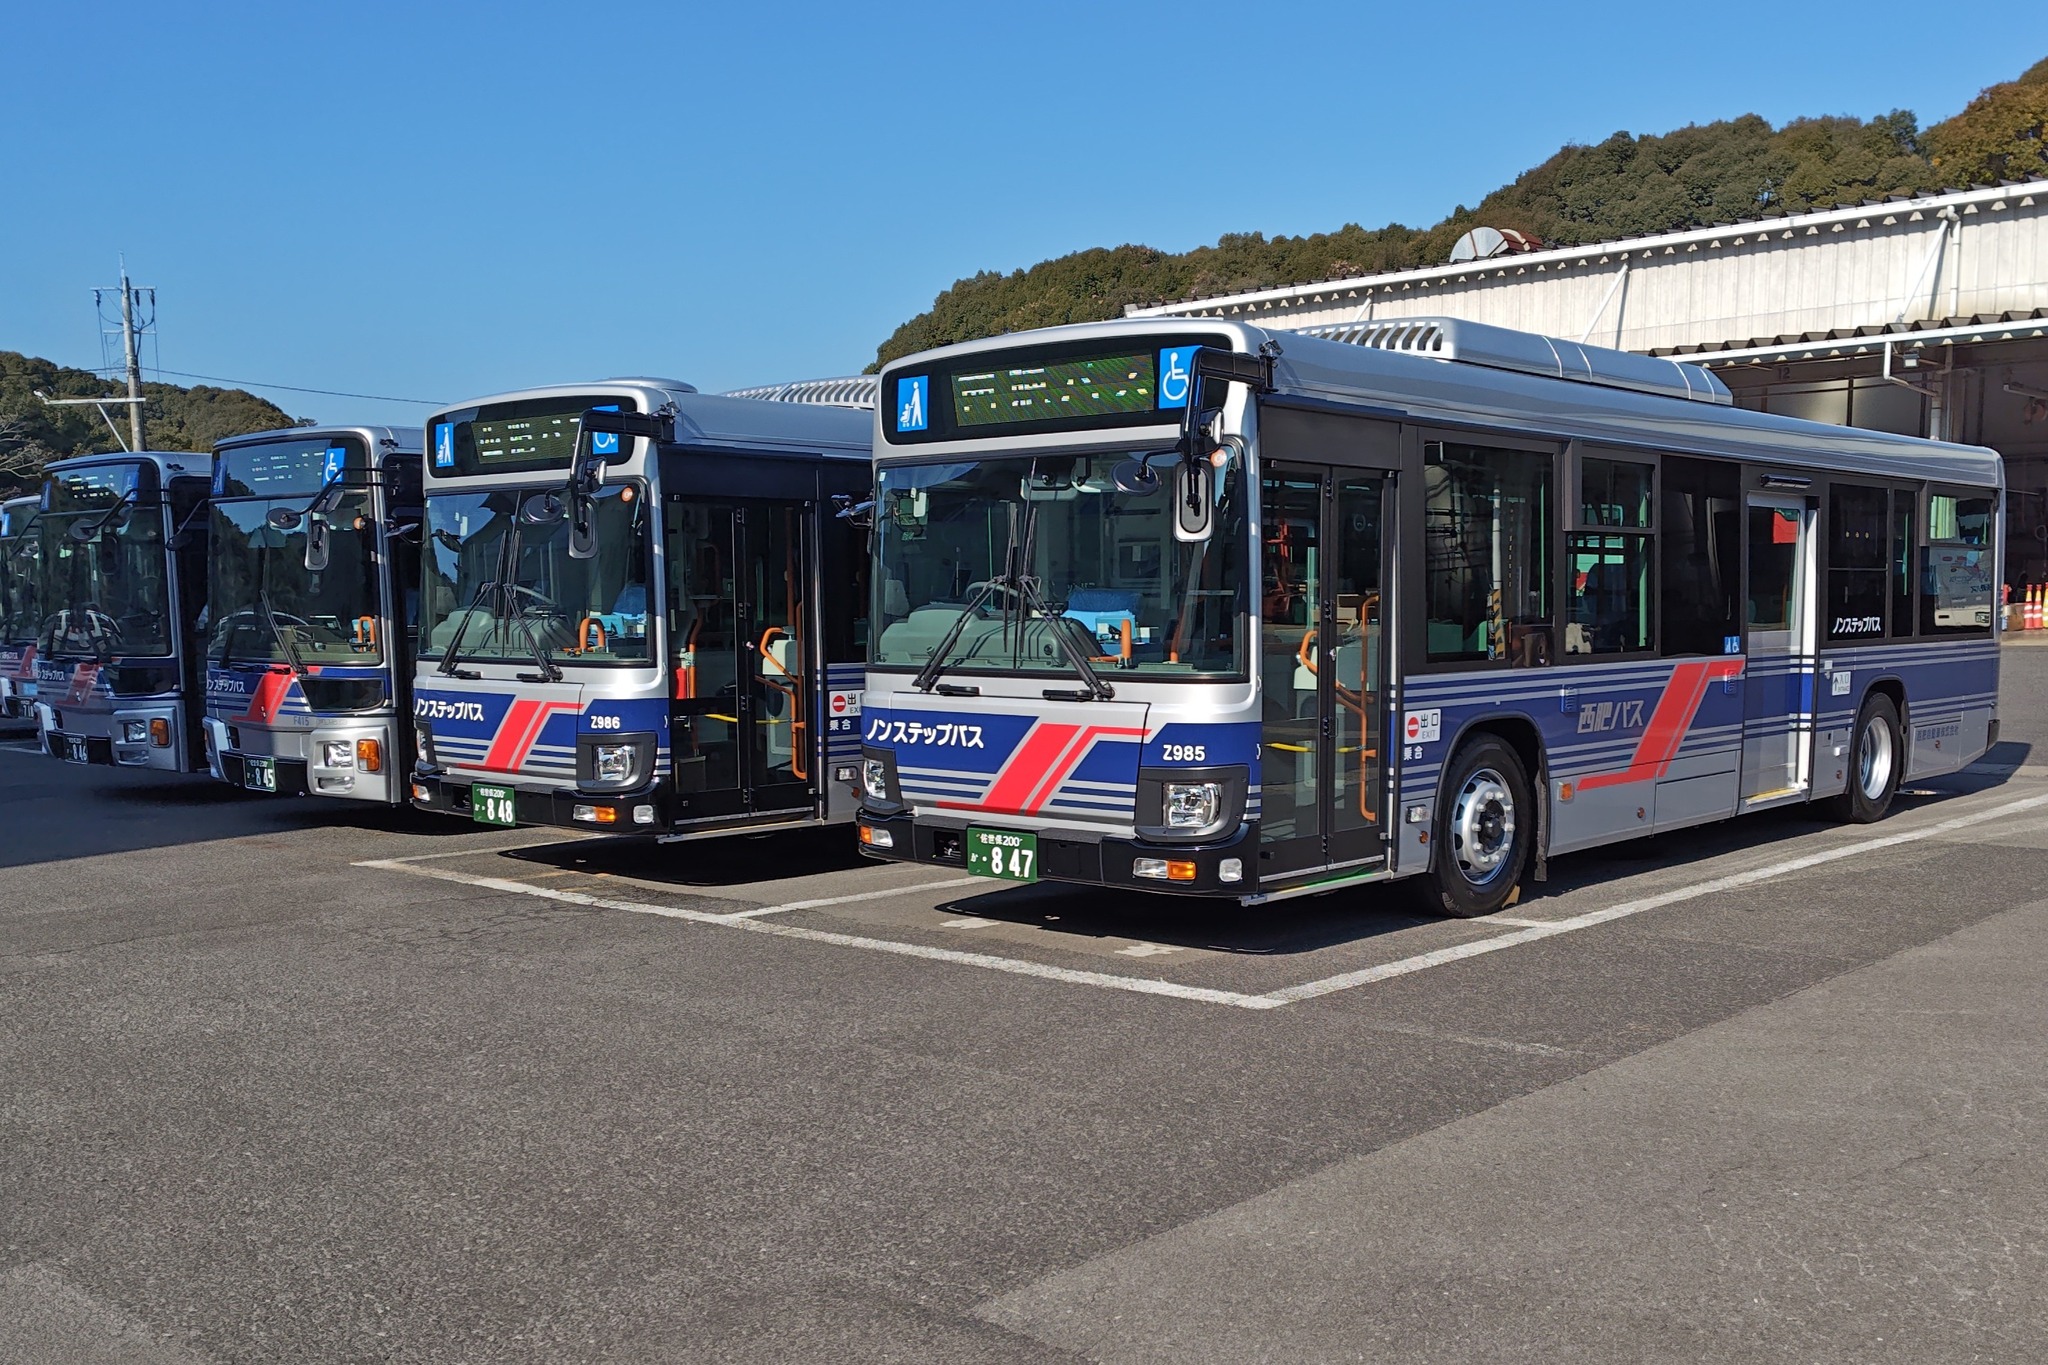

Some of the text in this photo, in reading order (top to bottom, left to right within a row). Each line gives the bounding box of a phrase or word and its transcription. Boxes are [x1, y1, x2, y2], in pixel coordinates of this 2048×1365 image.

[1832, 616, 1881, 633] ノンステップバス
[414, 698, 485, 722] ノンステップバス
[1577, 700, 1645, 733] 西肥バス
[590, 716, 621, 729] Z986
[829, 719, 851, 731] 乗合
[1420, 712, 1439, 728] 出口
[866, 718, 985, 749] ノンステップバス
[1422, 730, 1436, 740] EXIT
[1162, 744, 1206, 762] Z985
[1403, 746, 1424, 760] 乗合
